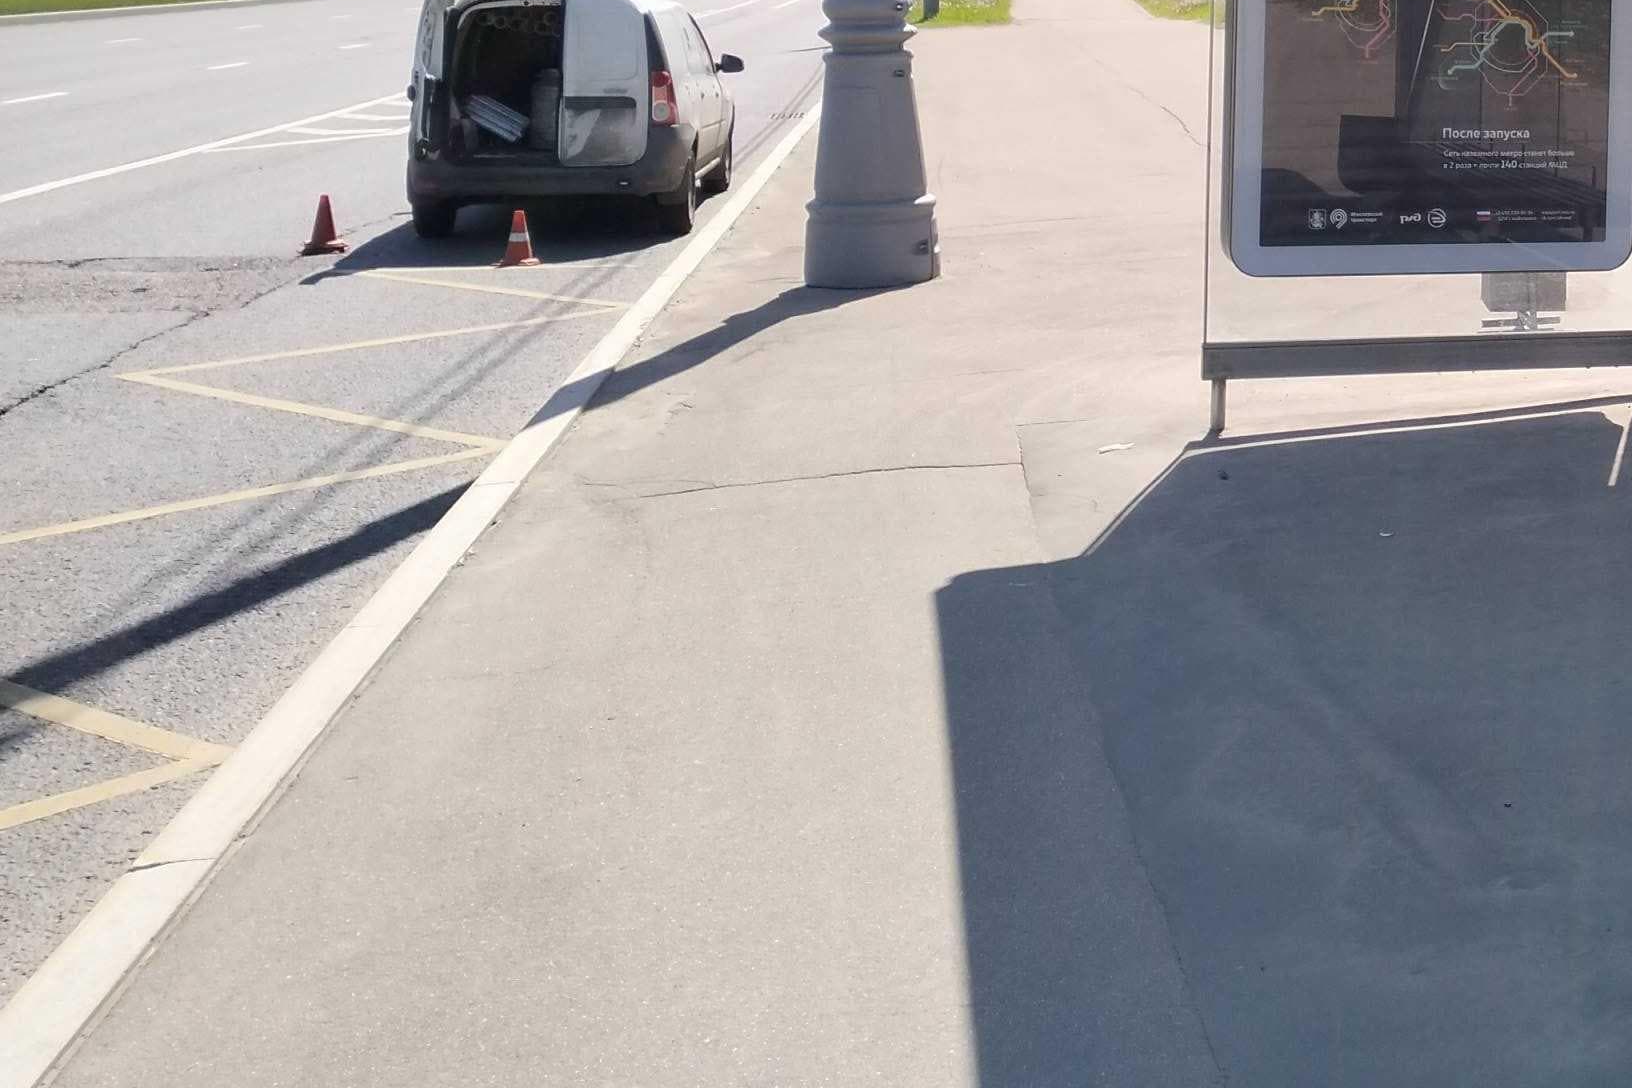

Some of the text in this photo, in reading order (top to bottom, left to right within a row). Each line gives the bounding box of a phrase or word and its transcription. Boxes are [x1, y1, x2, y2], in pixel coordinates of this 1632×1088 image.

[1442, 127, 1530, 141] После запуска
[1500, 160, 1517, 169] 140
